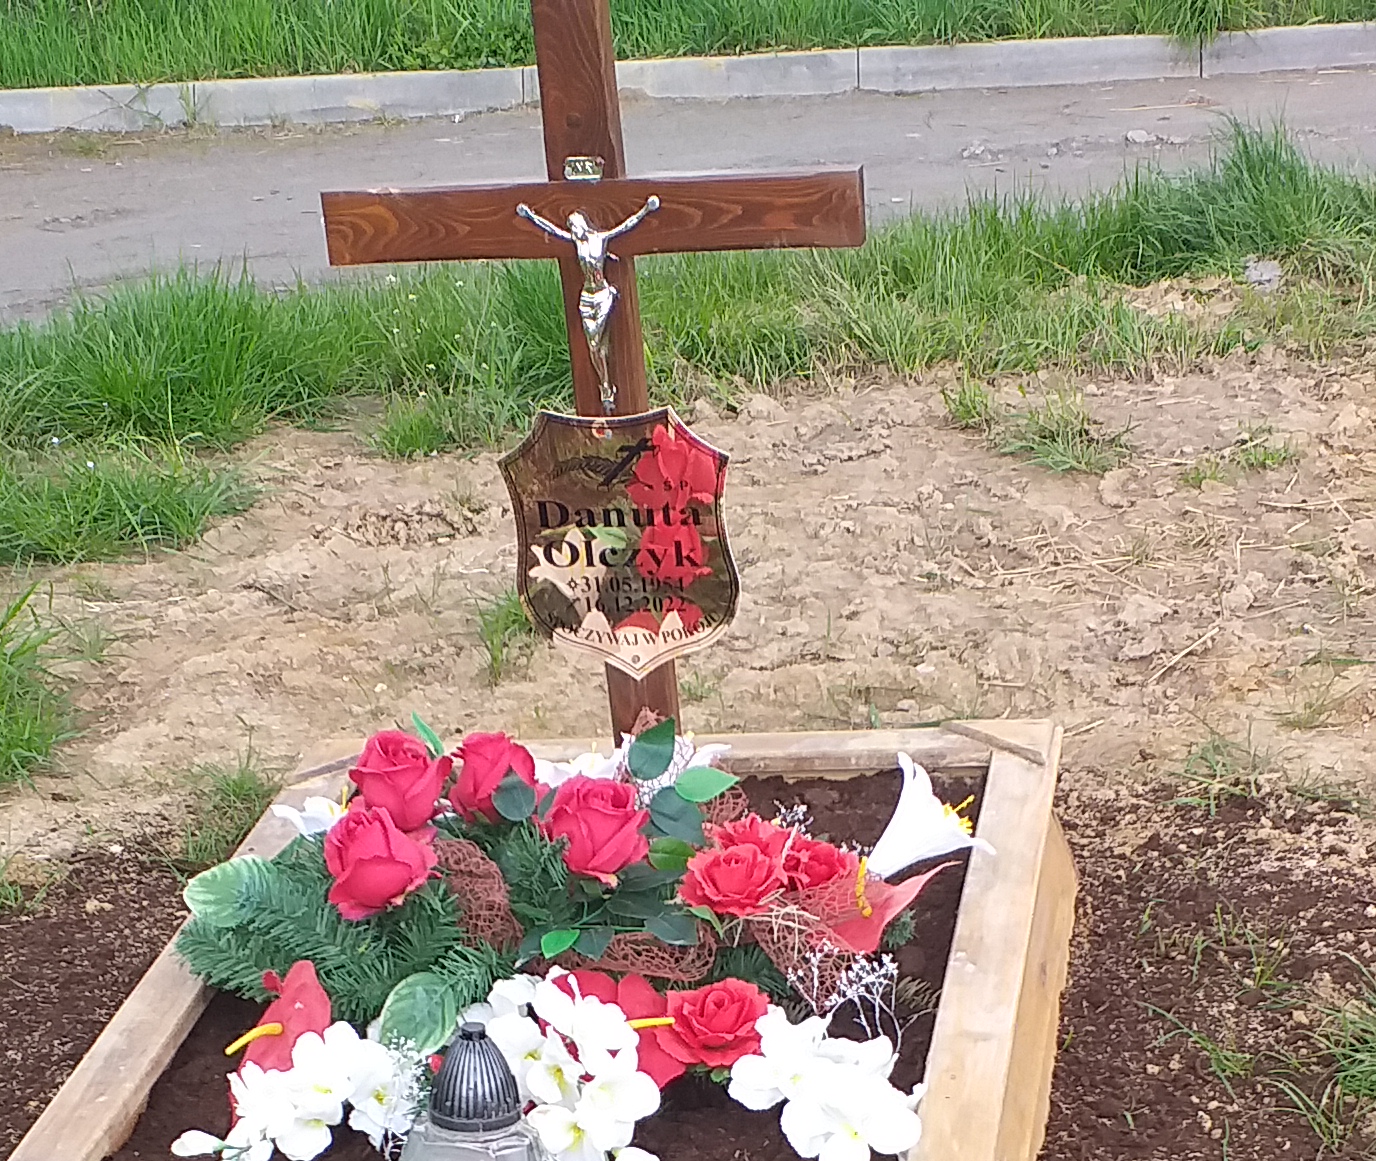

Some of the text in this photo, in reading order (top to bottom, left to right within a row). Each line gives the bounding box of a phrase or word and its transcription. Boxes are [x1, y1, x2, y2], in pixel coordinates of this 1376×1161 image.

[535, 499, 703, 528] Danuta
[542, 539, 701, 576] Olczyk
[643, 633, 658, 646] W
